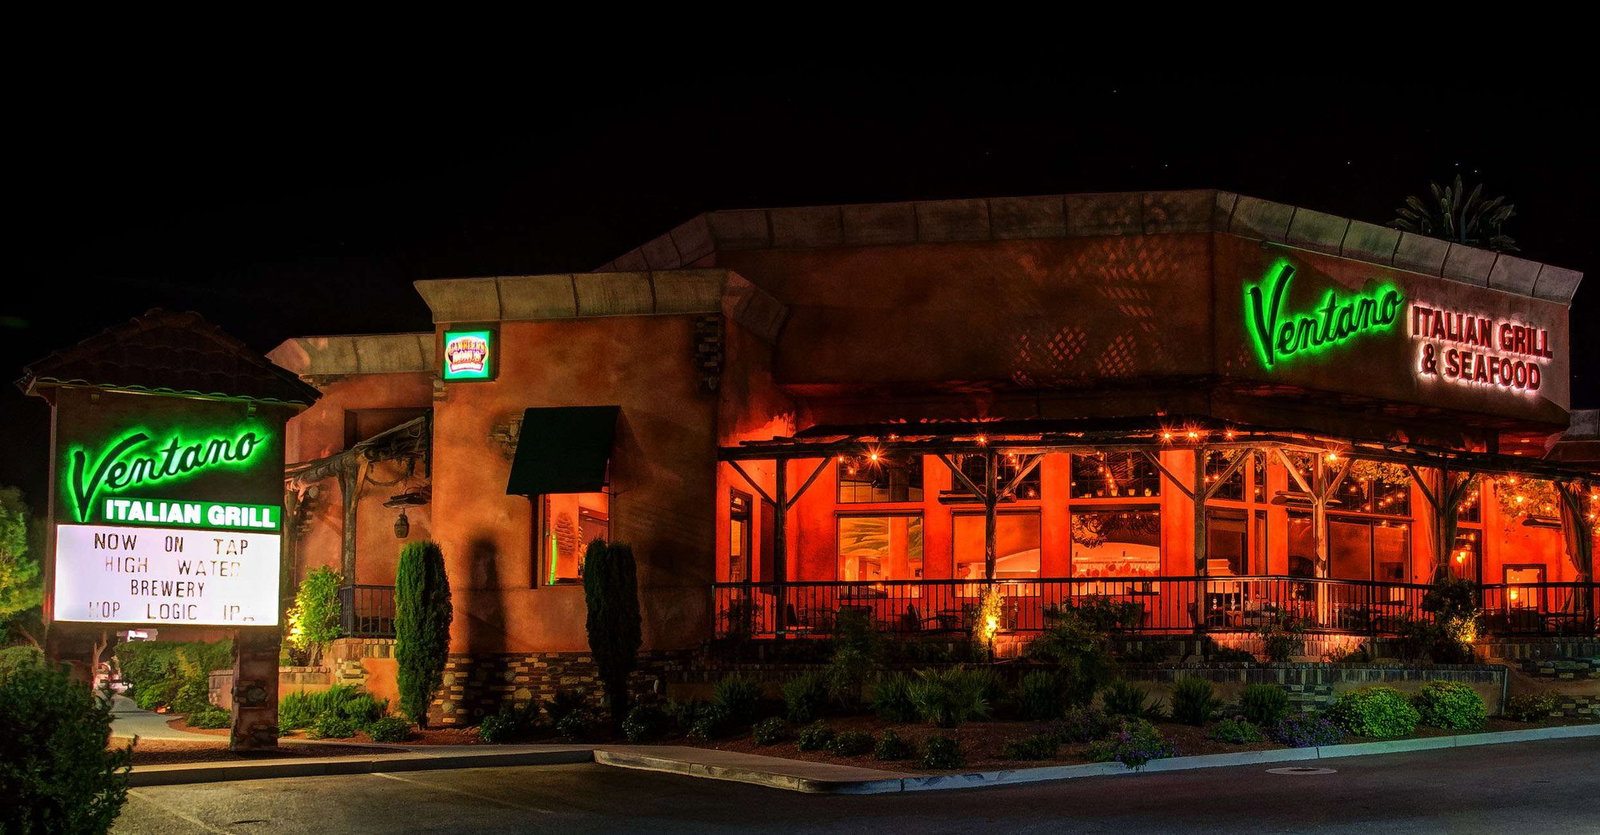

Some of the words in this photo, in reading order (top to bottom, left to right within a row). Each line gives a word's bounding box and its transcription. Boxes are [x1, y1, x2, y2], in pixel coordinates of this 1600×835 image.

[1248, 264, 1404, 366] Ventano
[1411, 305, 1492, 349] ITALIAN
[1500, 323, 1553, 359] GRILL
[1421, 343, 1437, 375] &
[1445, 348, 1541, 391] SEAFOOD
[72, 432, 267, 523] Ventano
[106, 499, 201, 525] ITALIAN
[207, 505, 276, 528] GRILL
[94, 533, 137, 551] NOW
[165, 536, 184, 553] ON
[213, 538, 249, 555] TAP
[105, 556, 148, 574] HIGH
[131, 579, 205, 598] BREWERY
[147, 603, 198, 621] LOGIC
[223, 605, 255, 622] IP
